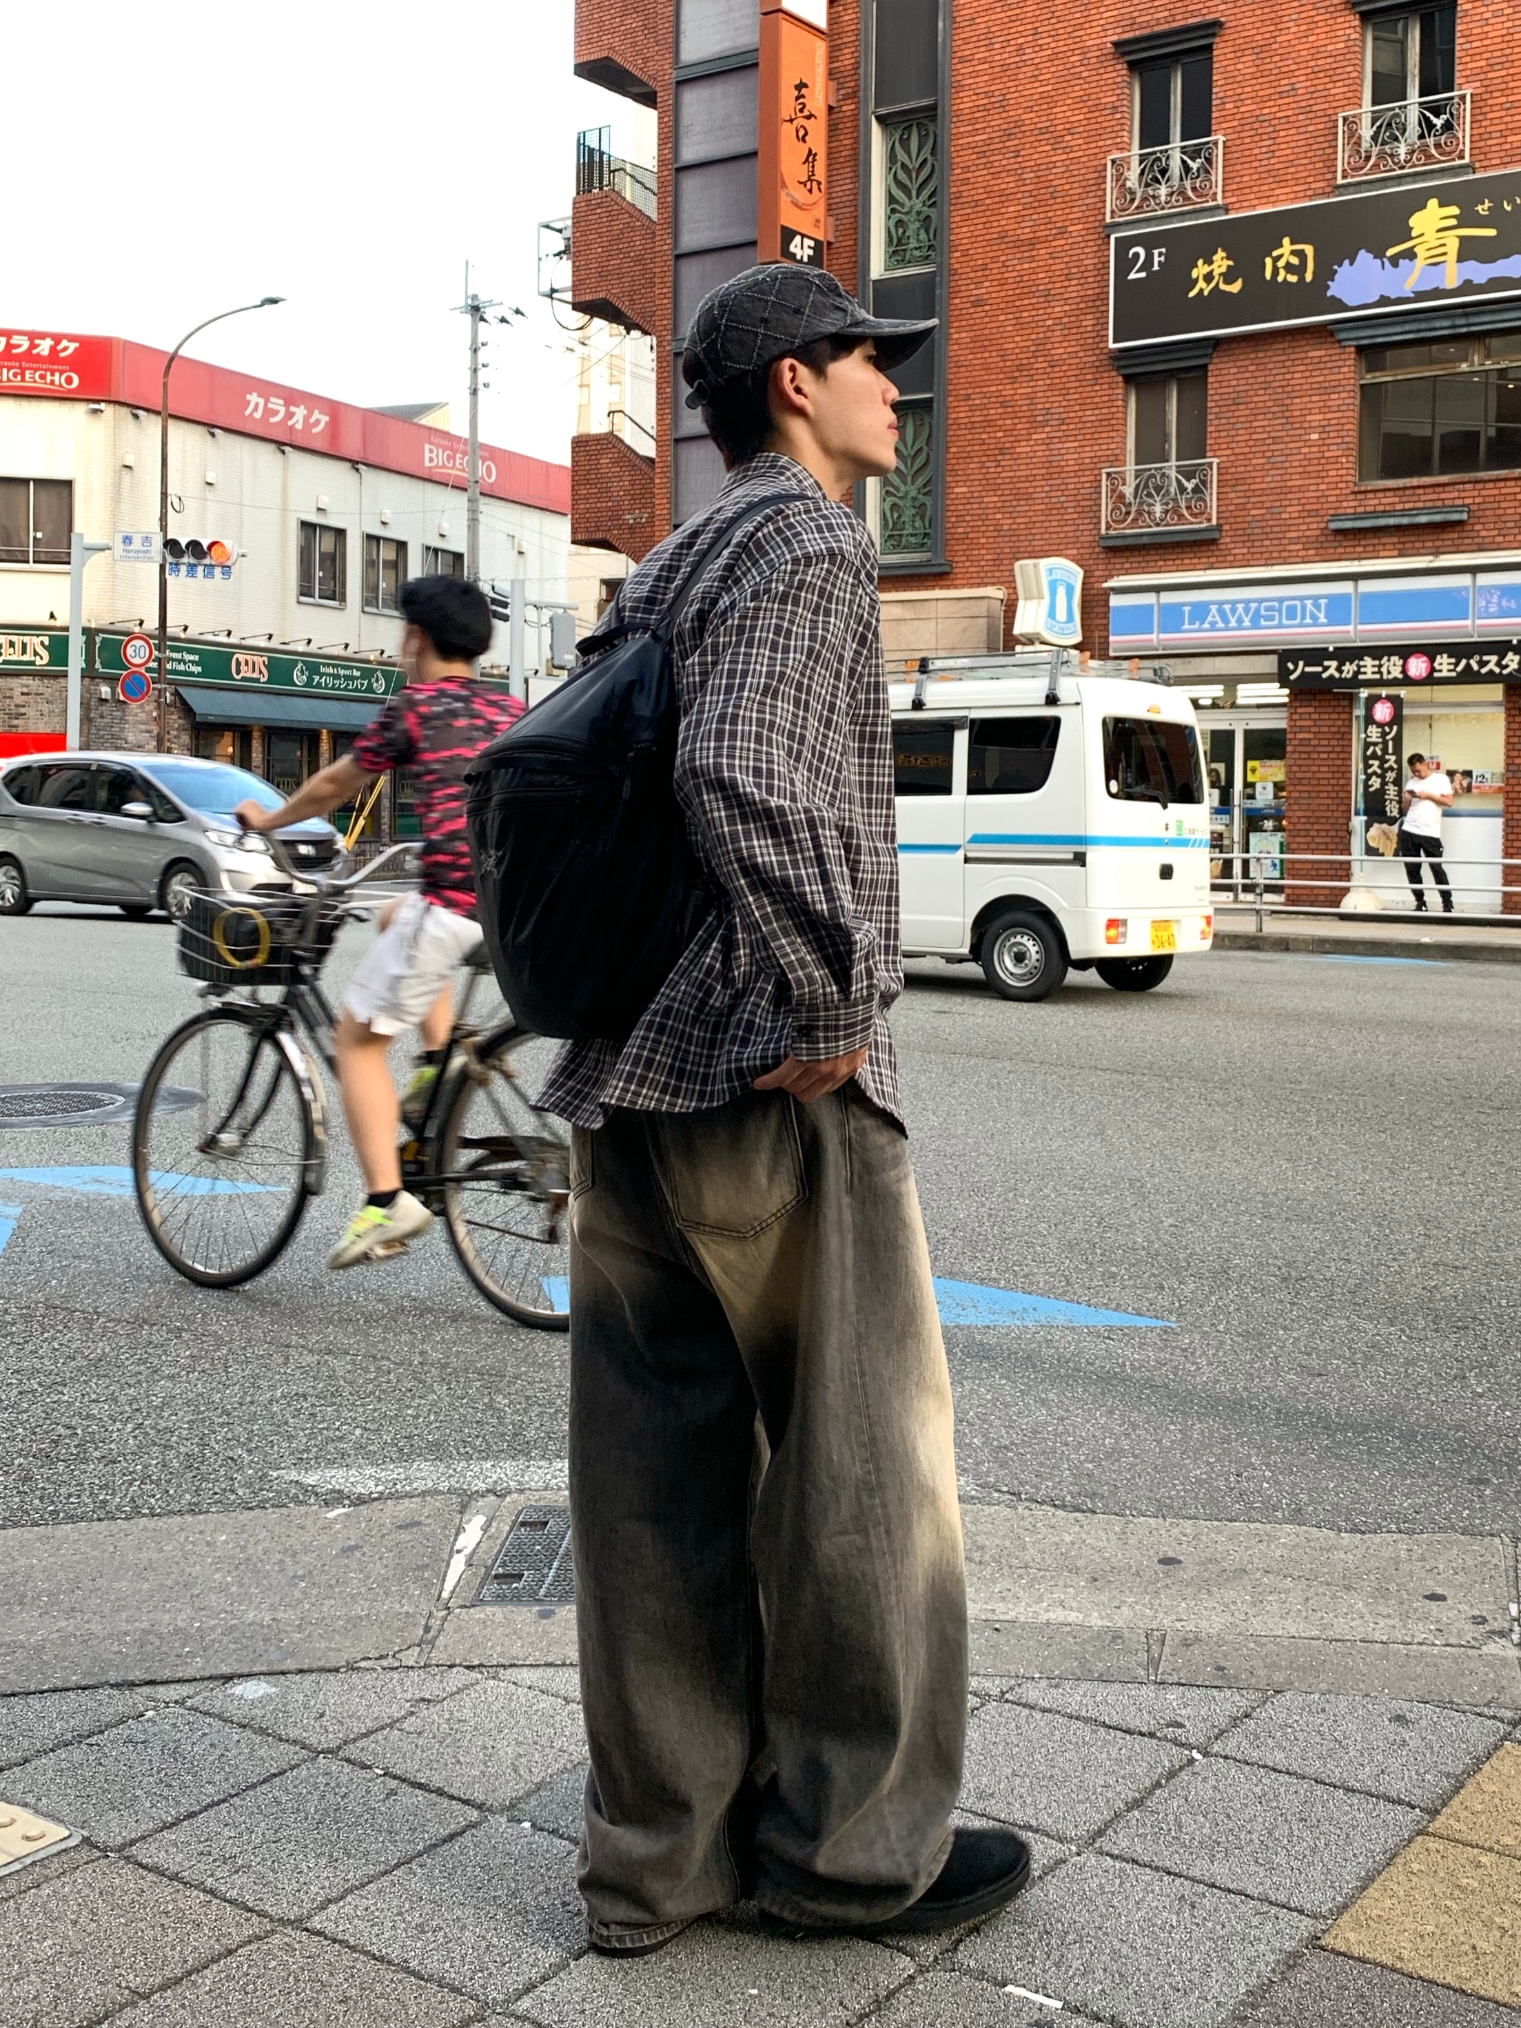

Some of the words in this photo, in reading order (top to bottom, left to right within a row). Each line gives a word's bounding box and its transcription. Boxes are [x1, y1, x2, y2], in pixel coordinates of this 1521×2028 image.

[789, 234, 815, 263] 4F
[1127, 246, 1167, 279] 2F
[1188, 236, 1314, 298] 焼肉
[1386, 197, 1498, 290] 青
[0, 368, 21, 382] IG
[25, 371, 80, 389] ECHO
[244, 392, 329, 434] カラオケ
[424, 443, 454, 468] BIG
[121, 535, 153, 547] 春吉
[168, 562, 232, 580] 時差信号
[1181, 598, 1329, 629] LAWSON
[129, 644, 147, 660] 30
[172, 661, 186, 671] Fish
[185, 663, 202, 675] Chips
[231, 653, 269, 682] CELTS
[1374, 702, 1393, 721] 新
[1366, 724, 1383, 792] 生パスタ
[1383, 725, 1400, 818] ソースが主役
